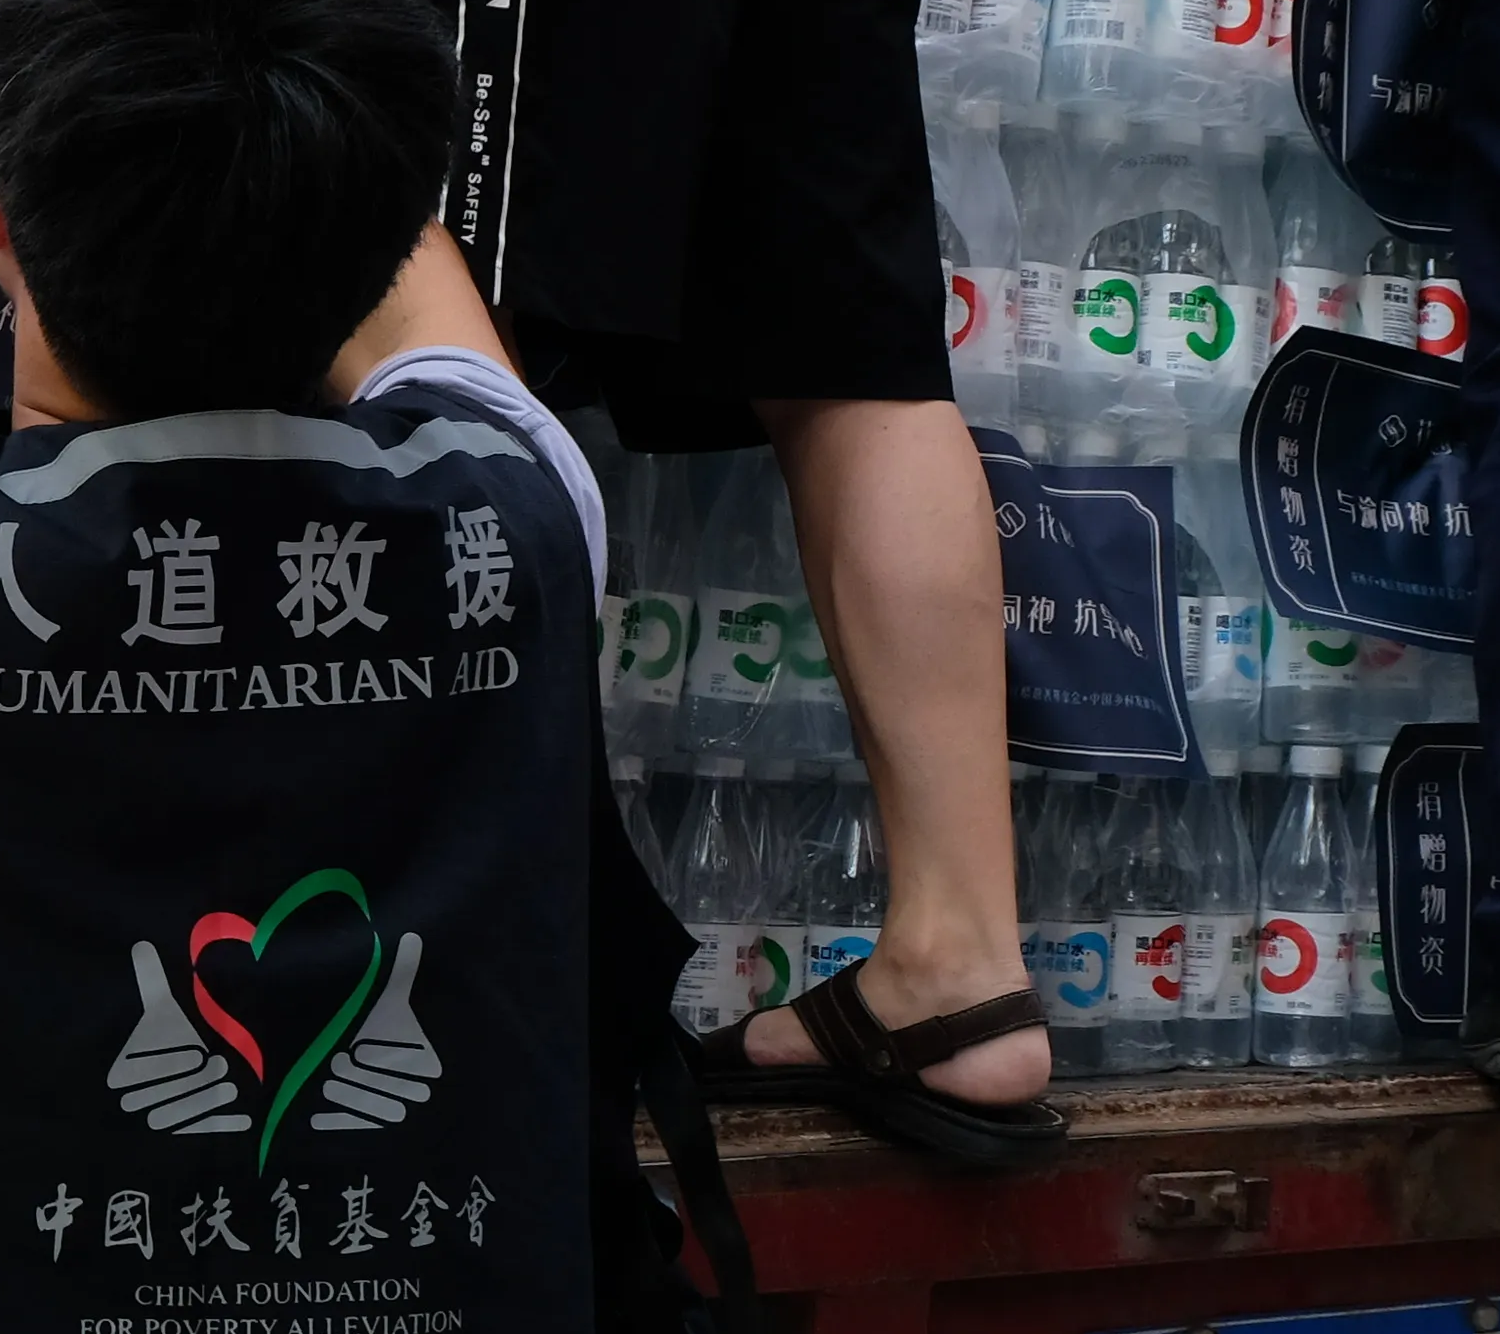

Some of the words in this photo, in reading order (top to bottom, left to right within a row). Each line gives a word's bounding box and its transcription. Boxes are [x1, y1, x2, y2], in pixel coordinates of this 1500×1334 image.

[1369, 73, 1448, 117] 与渝同
[460, 172, 483, 246] SAFETY
[447, 644, 520, 698] AID
[1416, 781, 1447, 978] 捐赠物资
[134, 1282, 223, 1308] CHINA
[236, 1277, 422, 1307] FOUNDATION
